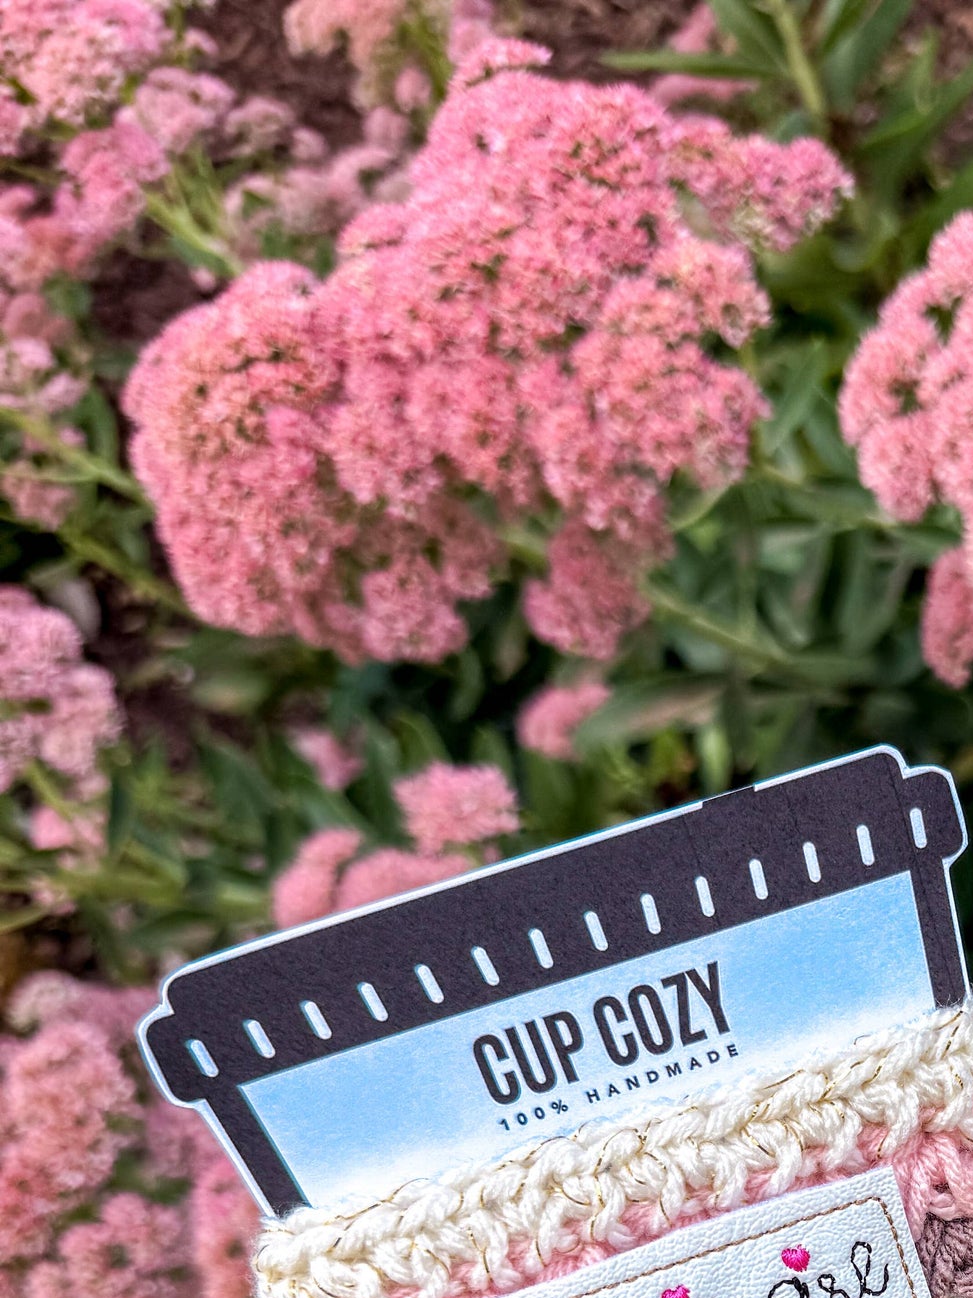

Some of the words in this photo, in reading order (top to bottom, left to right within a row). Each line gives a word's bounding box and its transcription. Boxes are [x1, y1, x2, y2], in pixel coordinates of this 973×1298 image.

[472, 1010, 585, 1106] CUP
[592, 960, 731, 1067] COZY
[498, 1099, 569, 1132] 100%
[586, 1043, 739, 1103] HANDMADE
